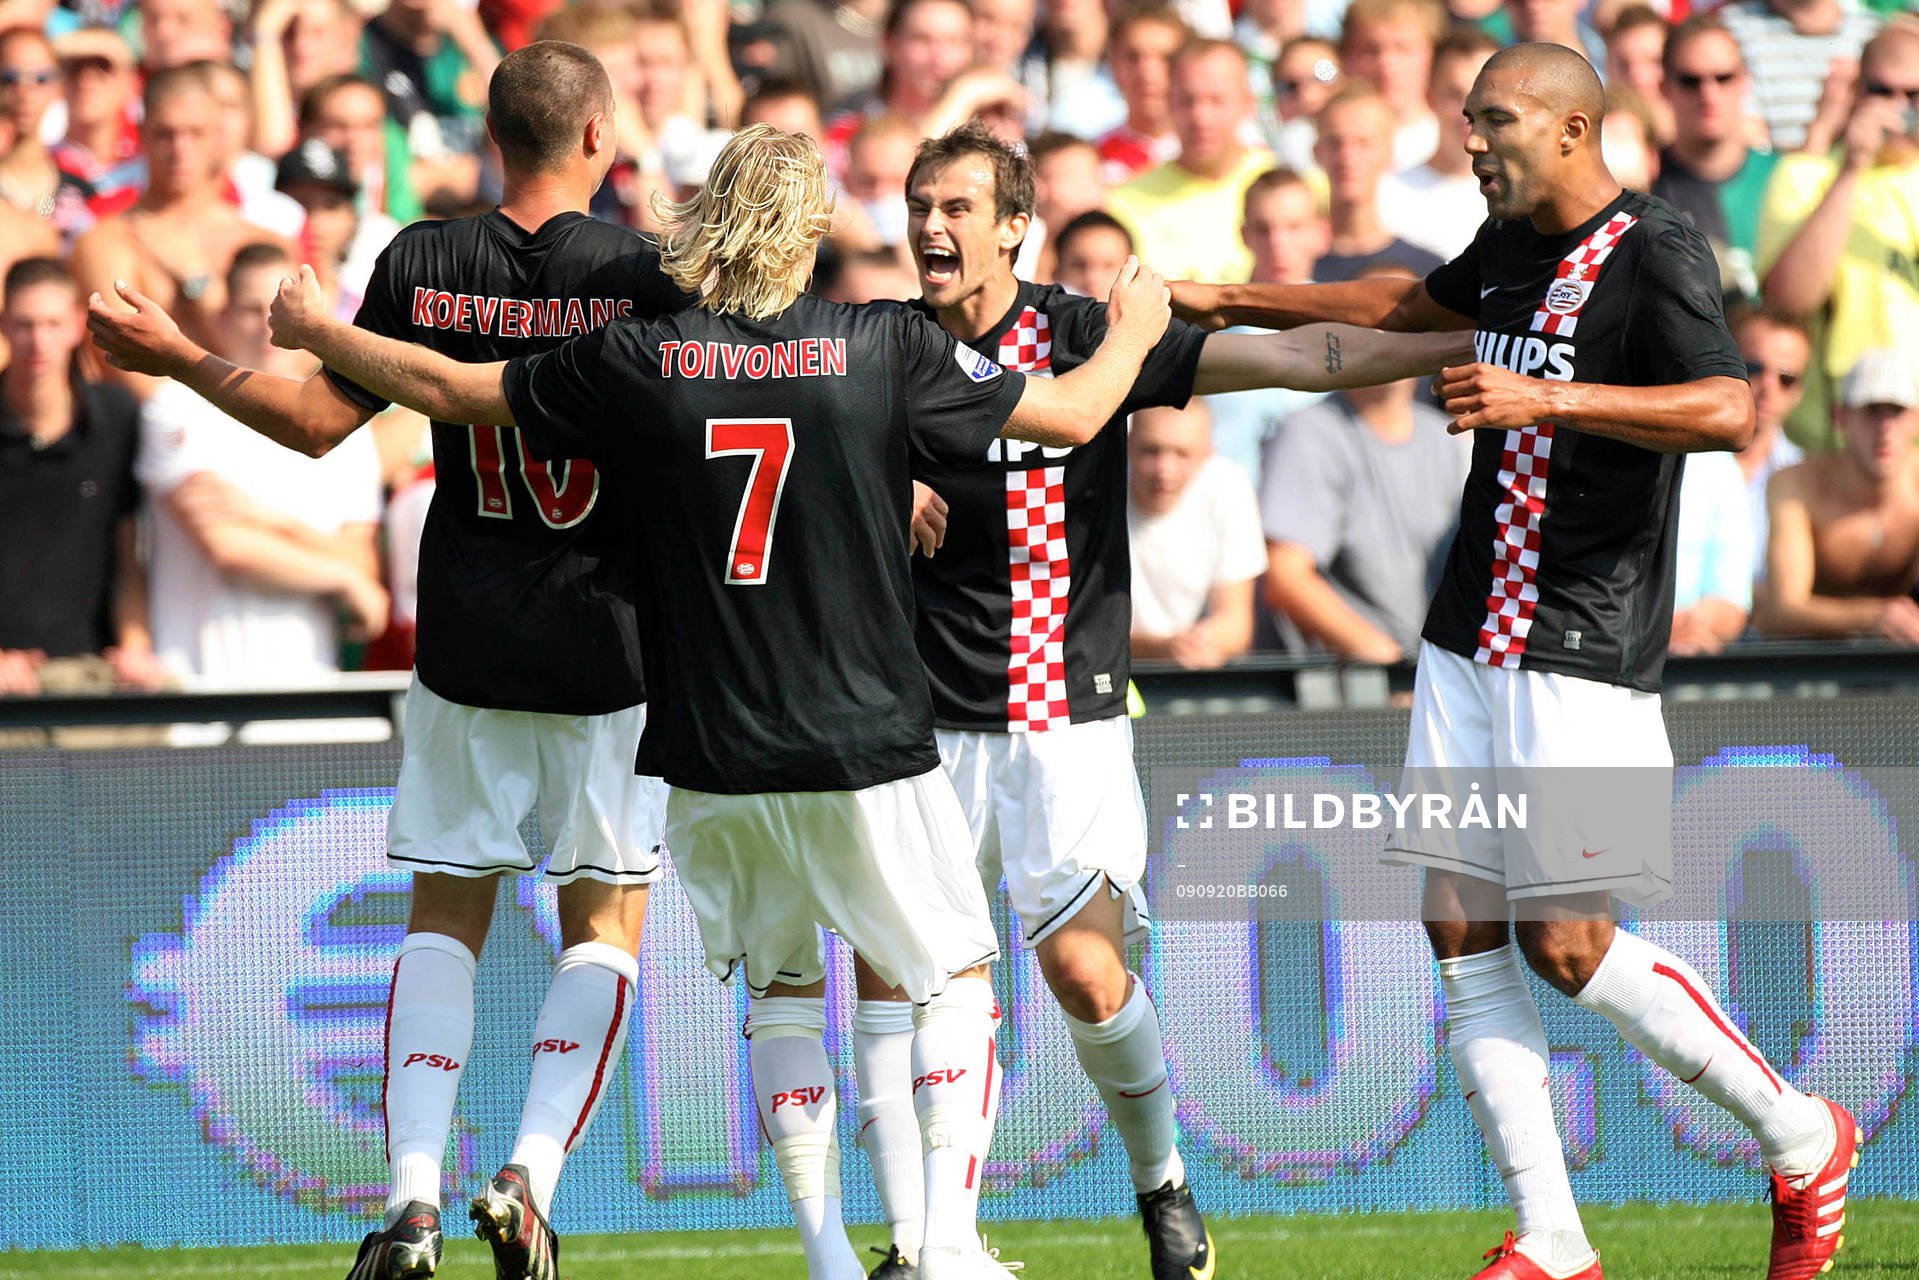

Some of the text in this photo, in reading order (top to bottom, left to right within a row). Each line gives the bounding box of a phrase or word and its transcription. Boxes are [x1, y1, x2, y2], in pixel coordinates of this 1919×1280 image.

[412, 286, 633, 338] KOEVERMANS
[658, 337, 847, 380] TOIVONEN
[705, 417, 796, 585] 7
[403, 1053, 461, 1072] PSV
[533, 1039, 580, 1062] PSV
[912, 1068, 967, 1095] PSV
[771, 1086, 826, 1114] PSV
